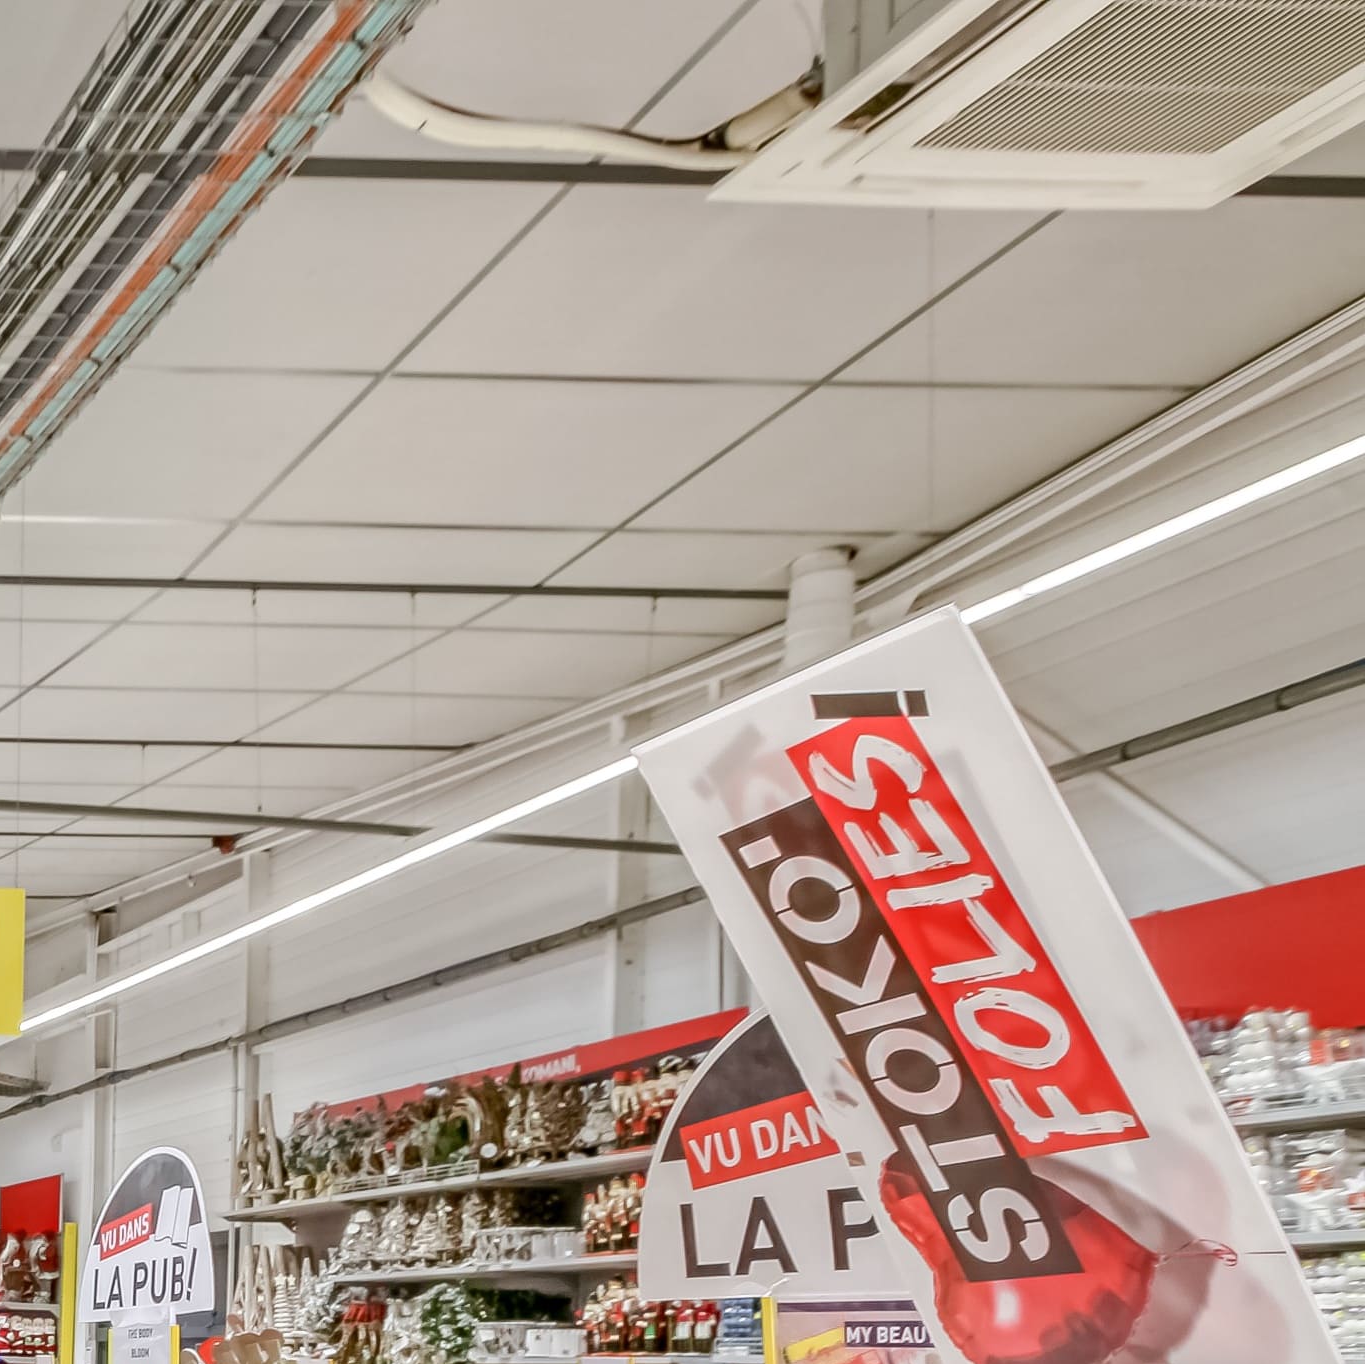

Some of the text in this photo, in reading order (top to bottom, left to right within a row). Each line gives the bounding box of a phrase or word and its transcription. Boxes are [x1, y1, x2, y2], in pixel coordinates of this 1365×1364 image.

[739, 834, 1052, 1264] STOKO'
[688, 1127, 741, 1174] VU
[101, 1213, 150, 1253] VU DANS
[679, 1196, 799, 1279] LA
[92, 1247, 197, 1310] LA PUB!
[846, 1326, 927, 1344] MY BEAU
